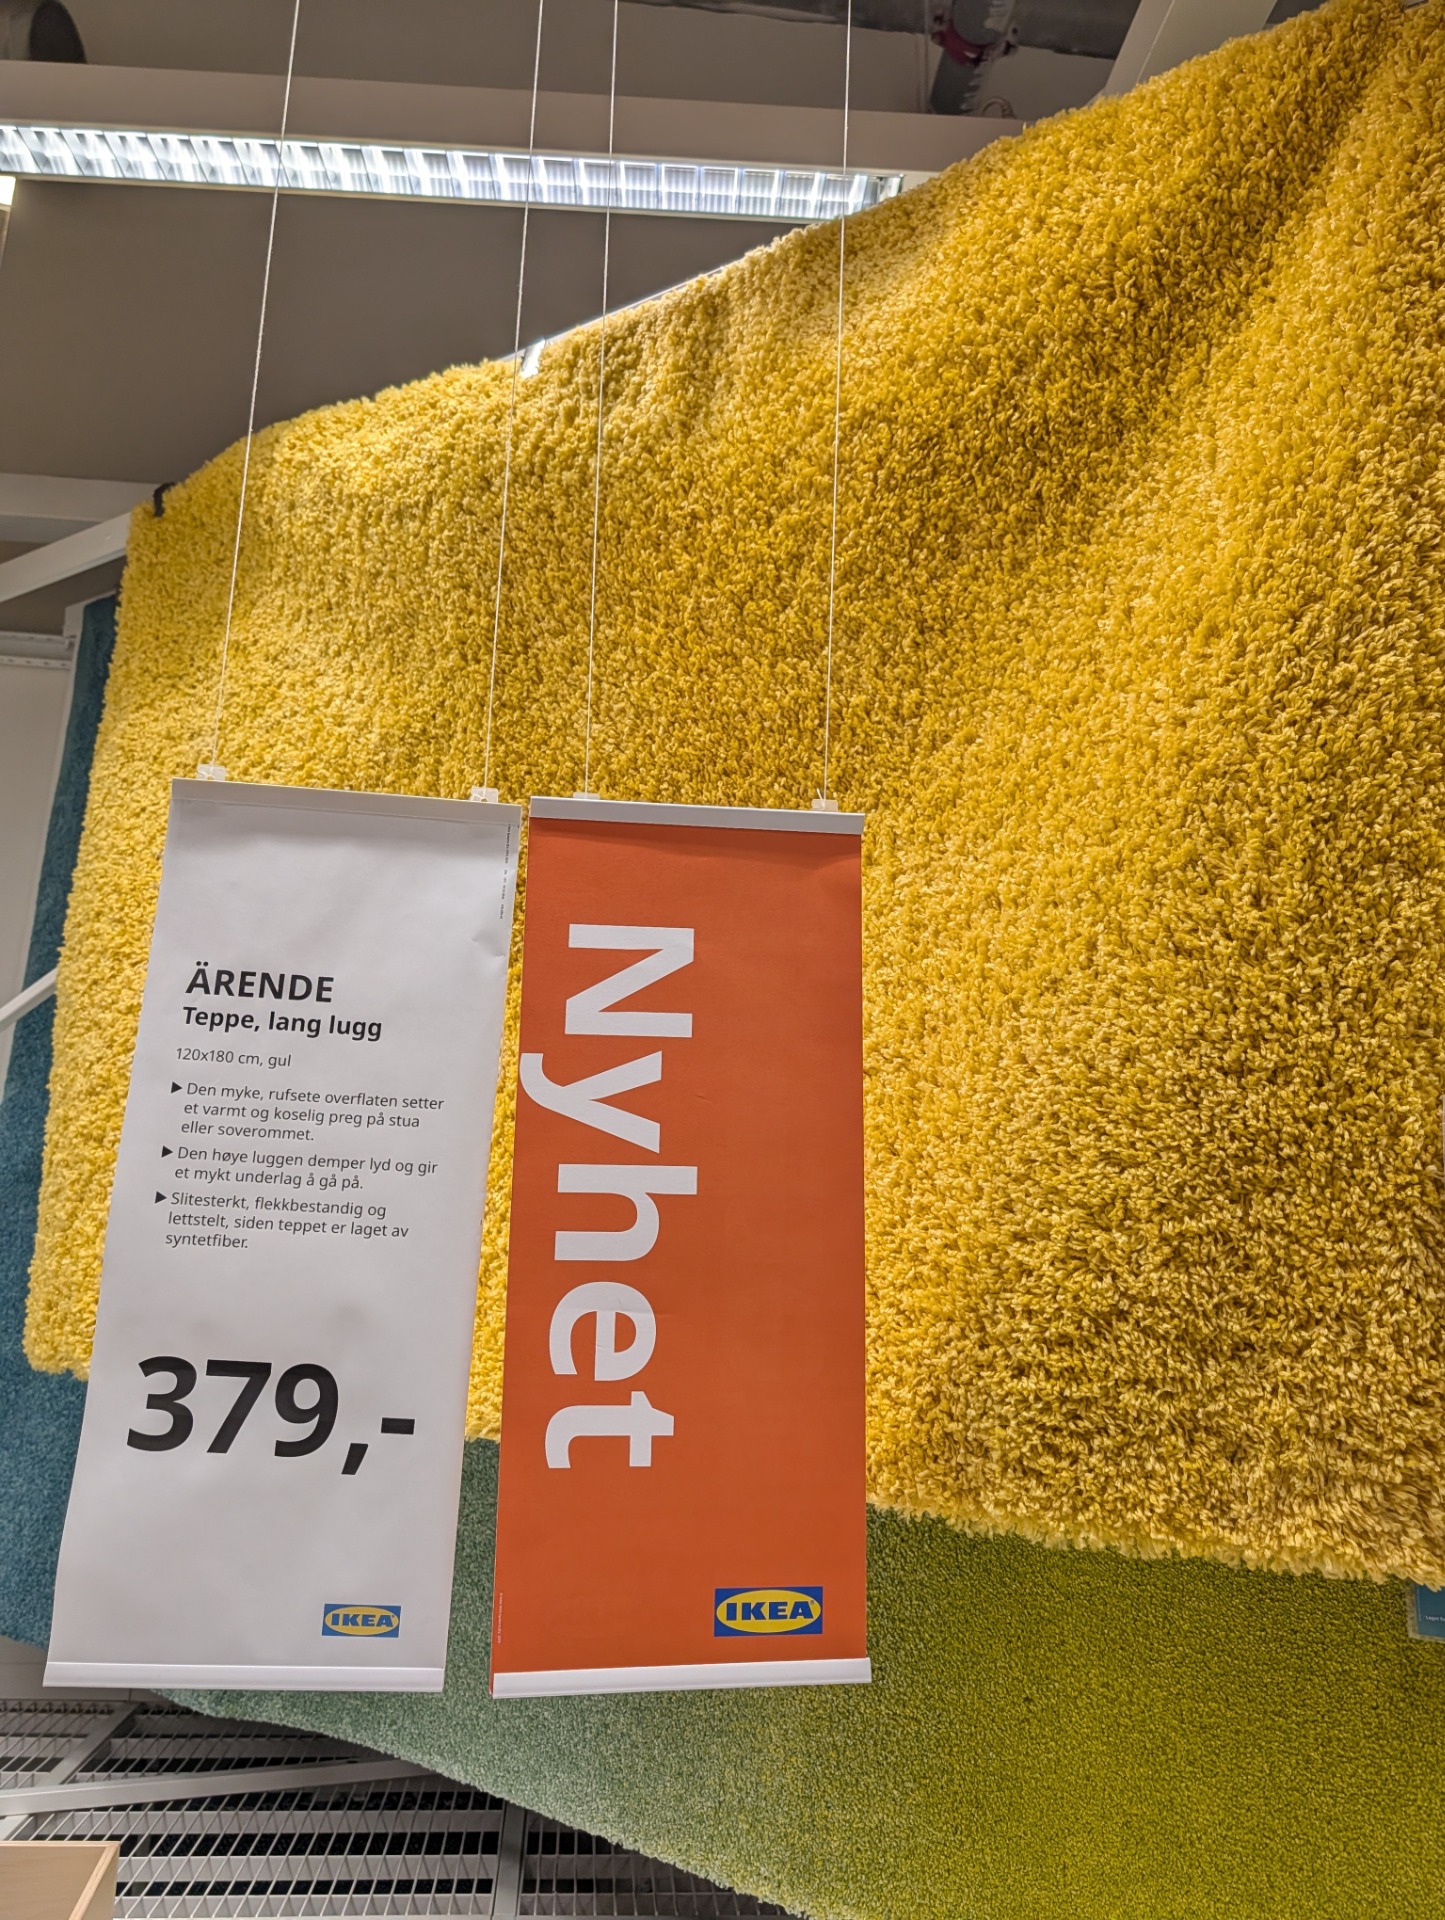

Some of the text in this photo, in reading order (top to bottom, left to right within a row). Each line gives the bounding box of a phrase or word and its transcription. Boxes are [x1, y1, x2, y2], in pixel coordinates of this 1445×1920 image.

[184, 960, 335, 1003] ÄRENDE
[182, 1006, 382, 1043] Teppe, lang lugg
[176, 1047, 292, 1070] 120x180 cm, gul
[186, 1082, 445, 1110] Den myke, rufsete overflaten setter
[183, 1102, 420, 1129] et varmt og koselig preg på stua
[181, 1120, 314, 1141] eller soverommet.
[177, 1146, 439, 1177] Den høye luggen demper lyd og gir
[174, 1167, 363, 1192] et mykt underlag å gå på.
[170, 1191, 387, 1221] Slitesterkt, flekkbestandig og
[518, 922, 699, 1470] Nyhet
[168, 1210, 409, 1240] lettstelt, siden teppet er laget av
[165, 1233, 248, 1249] syntetfiber.
[126, 1355, 416, 1476] 379,-
[331, 1613, 395, 1627] IKEA
[725, 1600, 816, 1621] IKEA
